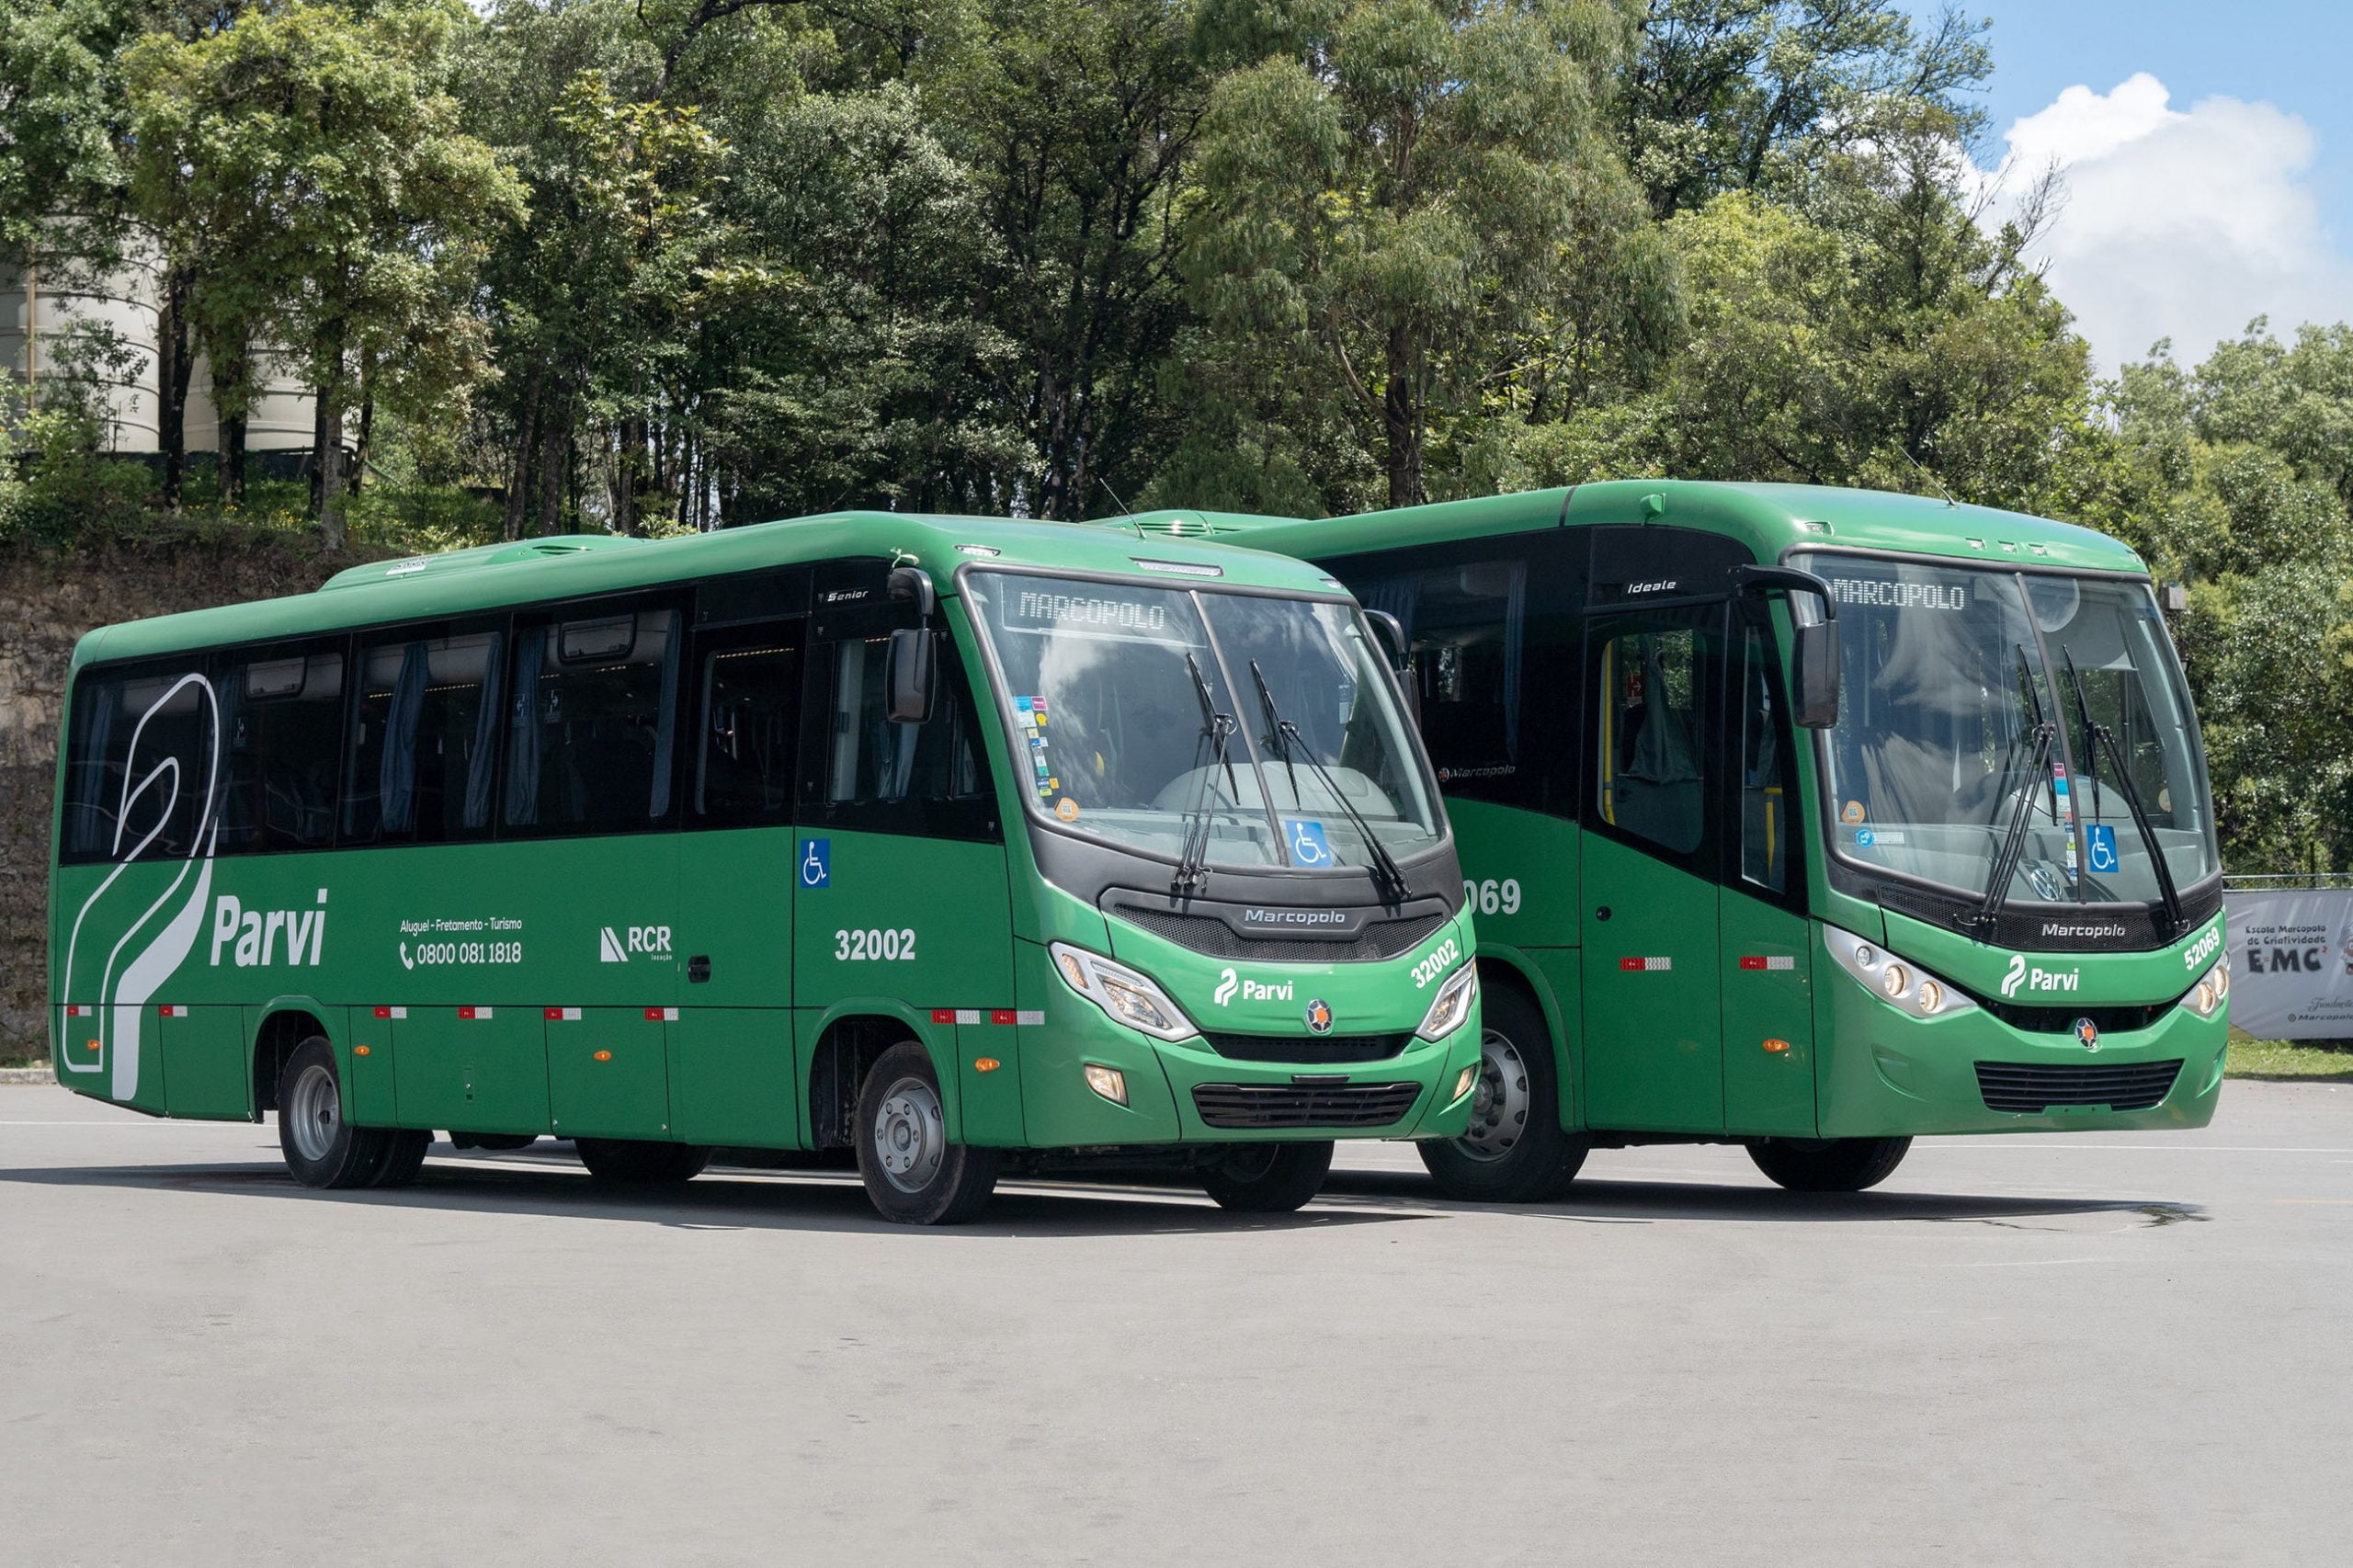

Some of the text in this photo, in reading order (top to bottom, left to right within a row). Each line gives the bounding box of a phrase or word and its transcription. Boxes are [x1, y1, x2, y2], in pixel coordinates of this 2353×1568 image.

[827, 590, 869, 602] Senior
[1627, 580, 1677, 594] Ideale
[1833, 579, 1964, 609] MARCOPOLO
[1020, 592, 1165, 630] MARCOPOLO
[1450, 765, 1516, 778] Marcopolo
[210, 888, 328, 967] Parvi
[400, 919, 430, 937] Aluguel
[436, 919, 483, 932] Fretamento
[490, 917, 522, 930] Turismo
[1245, 909, 1346, 926] Marcopolo
[628, 926, 673, 952] RCR
[2041, 924, 2126, 938] Marcopolo
[2245, 925, 2326, 934] Escola Marcopolo
[835, 928, 915, 960] 32002
[2184, 926, 2221, 971] 52069
[2247, 935, 2326, 946] de Criatividade
[417, 942, 521, 965] 0800 081 1818
[1411, 938, 1459, 990] 32002
[2029, 968, 2079, 992] Parvi
[1243, 981, 1293, 1001] Parvi
[2308, 994, 2353, 1012] Fundaçã
